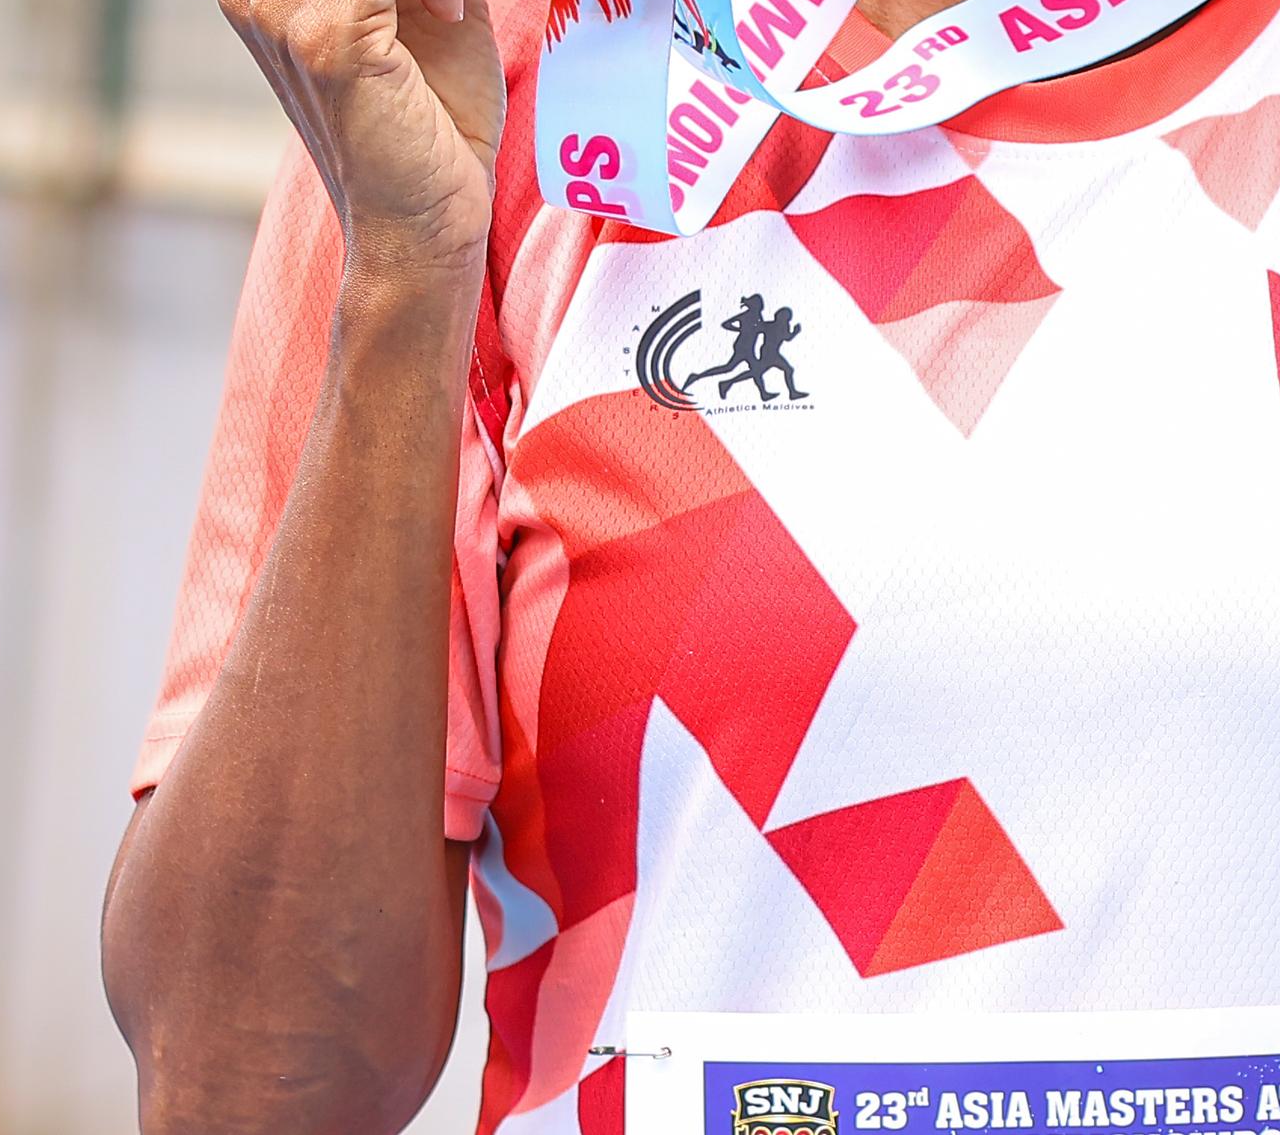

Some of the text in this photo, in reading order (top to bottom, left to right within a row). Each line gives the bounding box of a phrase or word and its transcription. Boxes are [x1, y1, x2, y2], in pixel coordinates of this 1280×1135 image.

[839, 25, 969, 118] 23RD
[705, 403, 815, 416] Athletics Maldives
[744, 1086, 824, 1115] SNJ
[855, 1086, 929, 1129] 23rd
[935, 1091, 1034, 1129] ASIA
[1046, 1086, 1245, 1127] MASTERS
